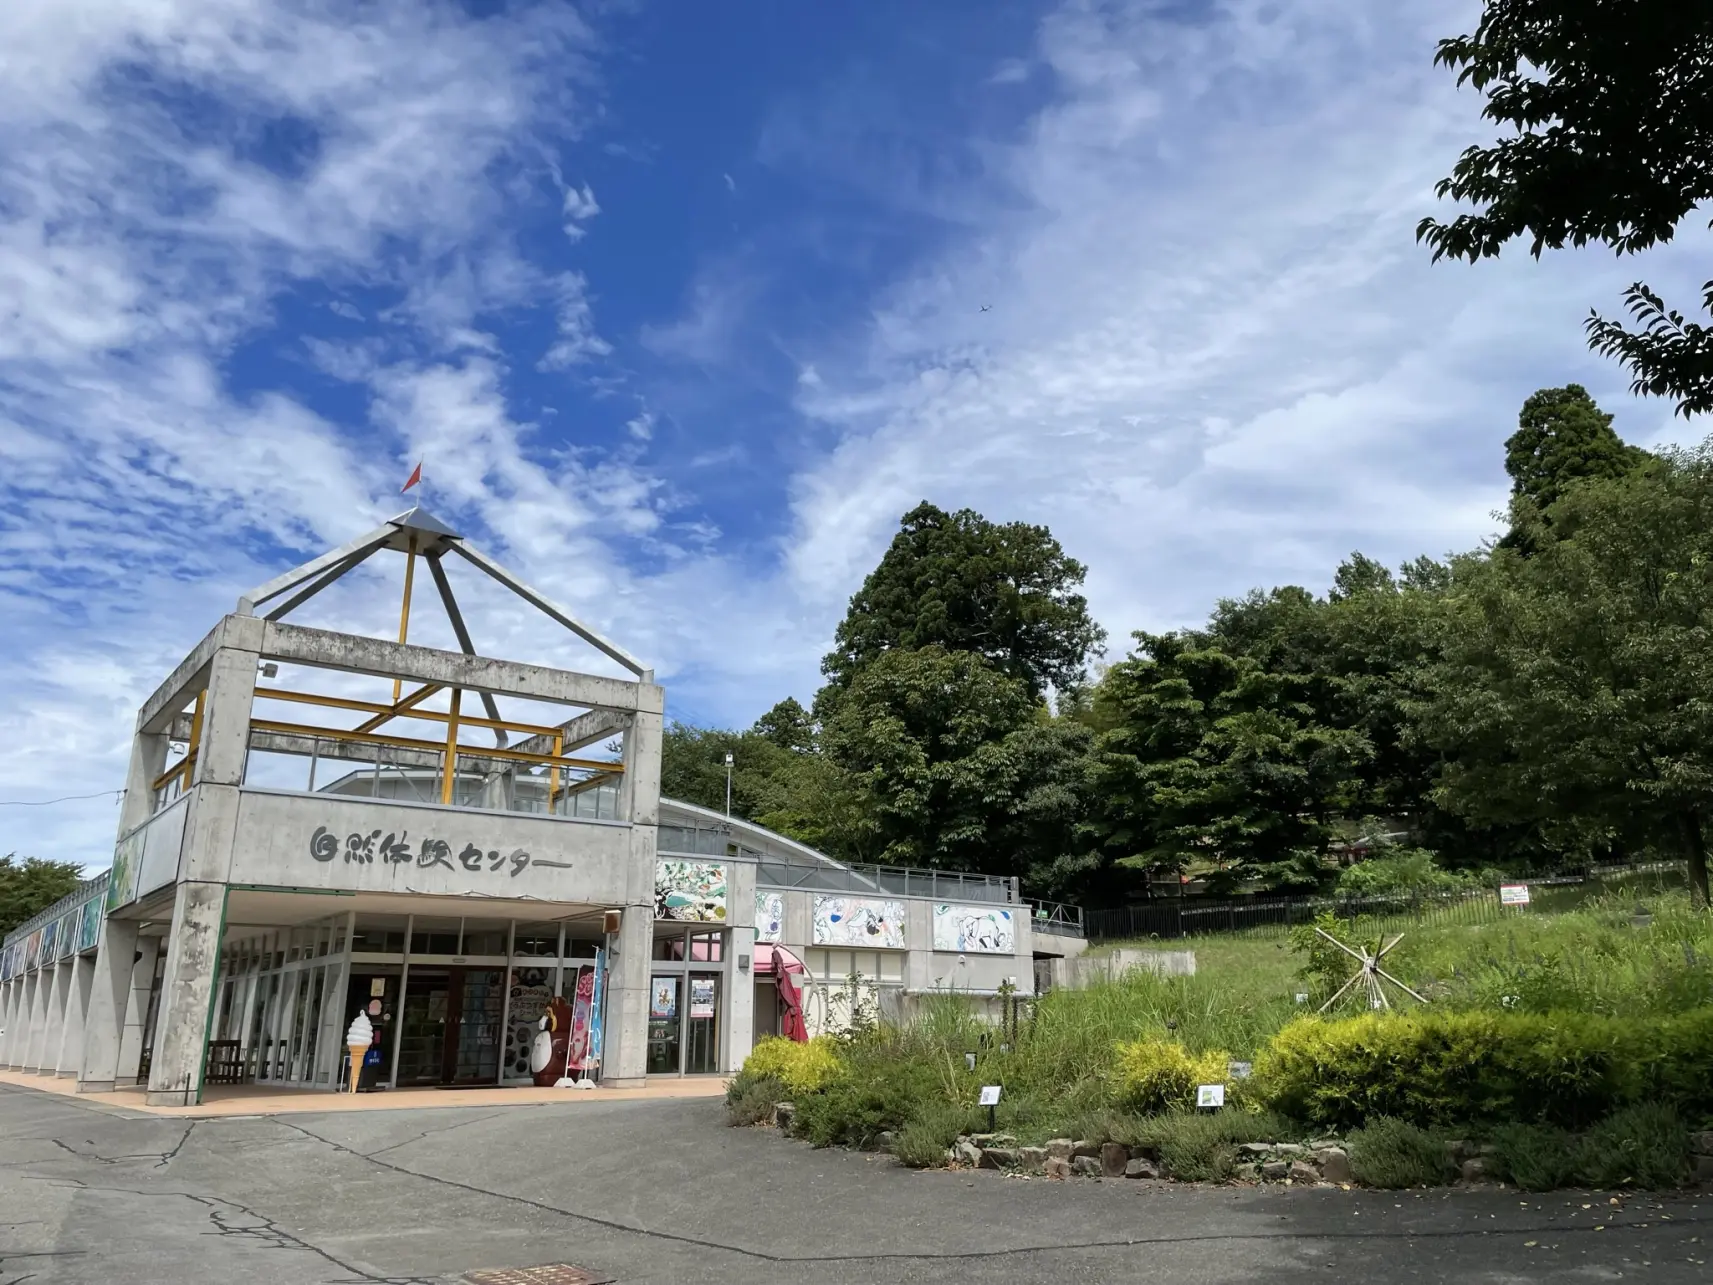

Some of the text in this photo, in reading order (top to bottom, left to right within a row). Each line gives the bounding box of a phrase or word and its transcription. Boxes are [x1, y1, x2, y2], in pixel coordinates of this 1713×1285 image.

[310, 826, 573, 877] 自然体験センター
